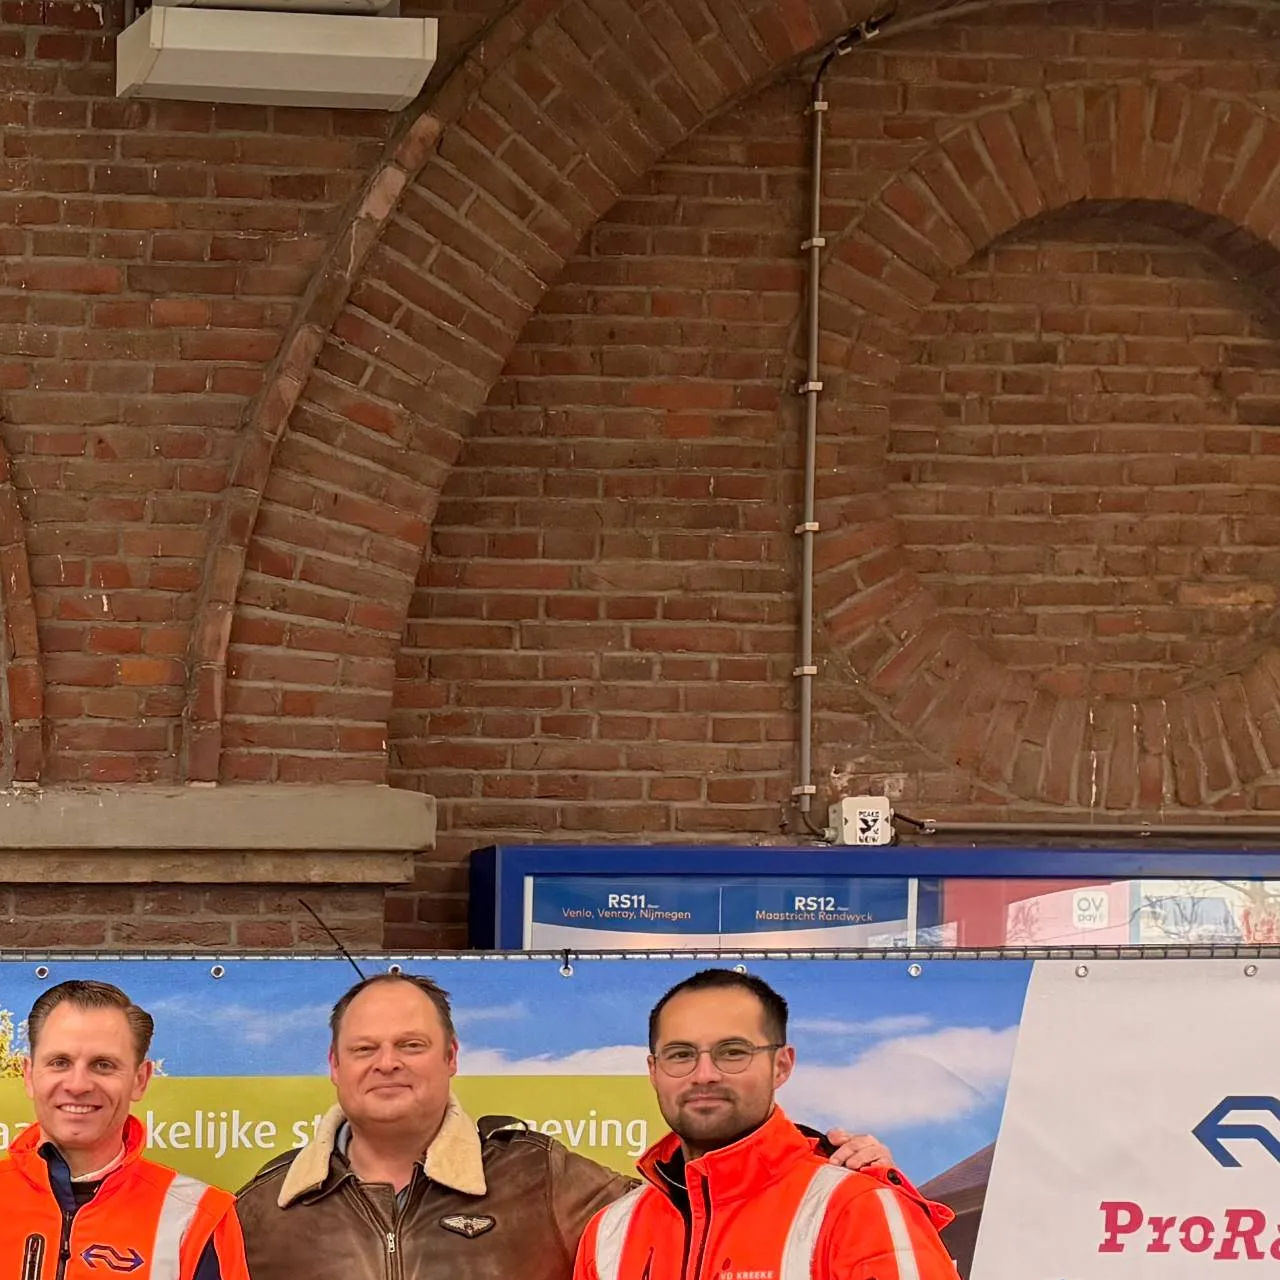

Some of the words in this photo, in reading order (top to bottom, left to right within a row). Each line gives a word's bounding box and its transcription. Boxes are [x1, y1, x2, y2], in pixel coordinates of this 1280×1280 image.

[608, 894, 646, 908] RS11
[795, 896, 835, 911] RS12
[1077, 897, 1104, 911] OV
[562, 908, 594, 919] Venlo,
[597, 909, 636, 920] Venray,
[640, 908, 691, 921] Nijmegen
[755, 910, 815, 921] Maastricht
[818, 911, 873, 922] Randwyck
[1098, 1201, 1280, 1260] ProR
